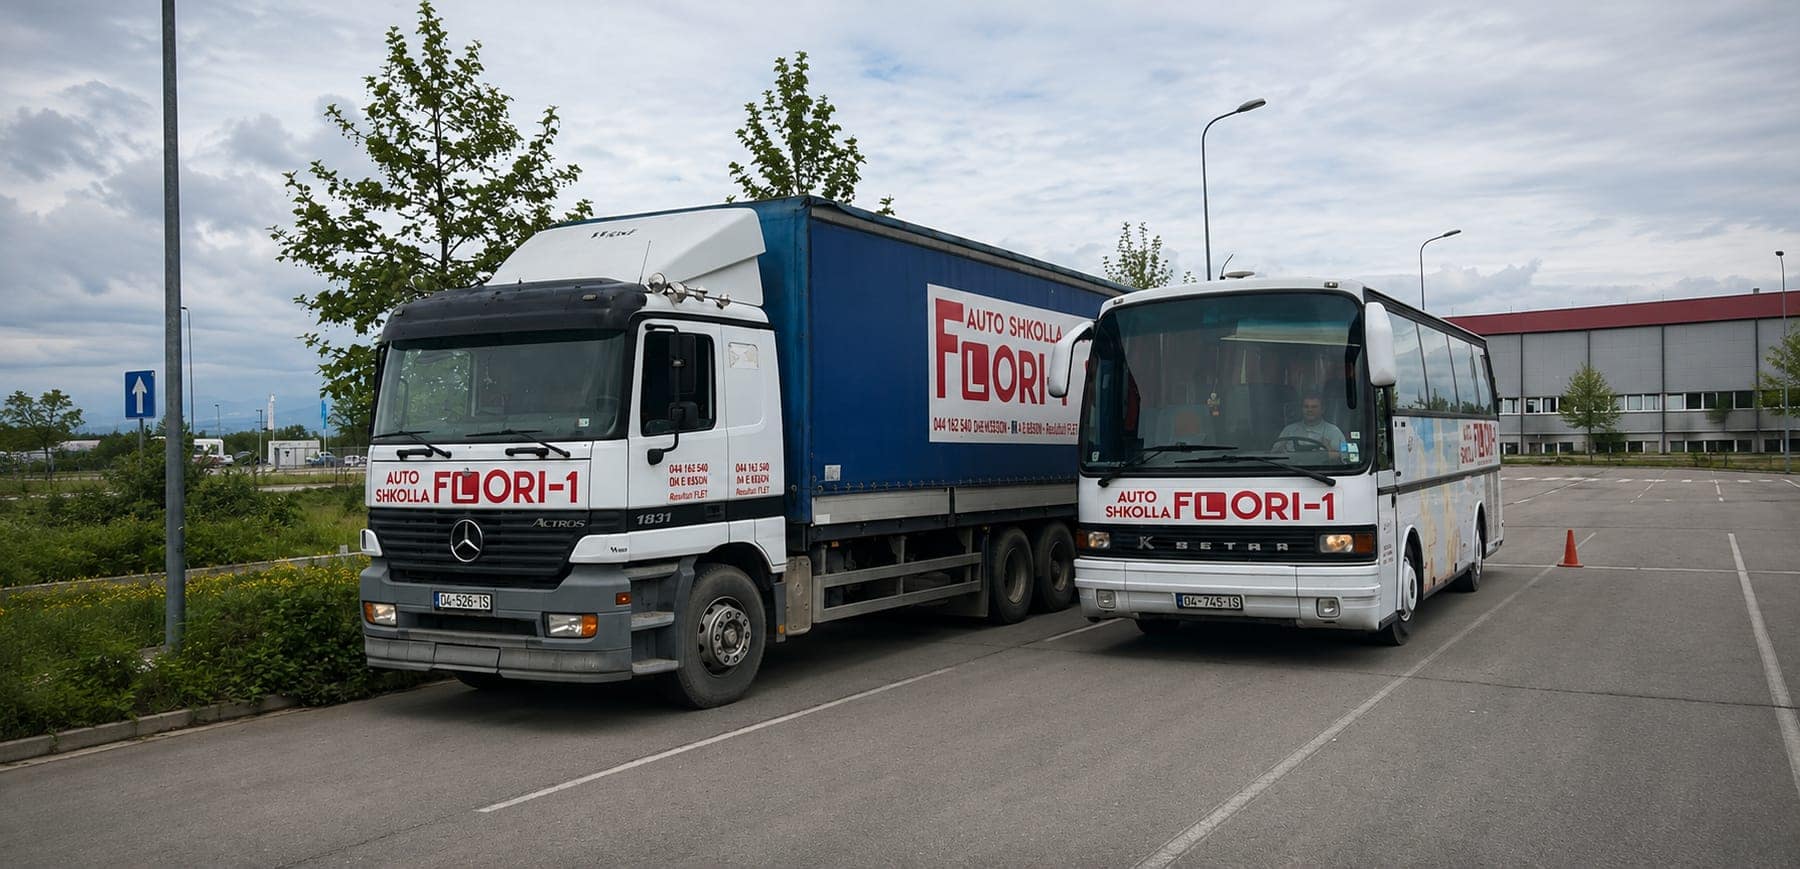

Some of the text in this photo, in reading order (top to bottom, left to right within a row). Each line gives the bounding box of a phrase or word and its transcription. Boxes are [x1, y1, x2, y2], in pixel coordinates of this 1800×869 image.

[967, 308, 1062, 343] AUTO SHKOLLA
[935, 298, 1068, 406] FLORI
[933, 417, 946, 431] 044
[386, 470, 419, 485] AUTO
[433, 468, 578, 504] FLORI-1
[375, 488, 430, 503] SHKOLLA
[1117, 490, 1157, 504] AUTO
[1105, 506, 1171, 519] SHKOLLA
[1173, 490, 1335, 521] FLORI-1
[636, 512, 672, 525] 1831
[1138, 536, 1289, 551] K SETRA
